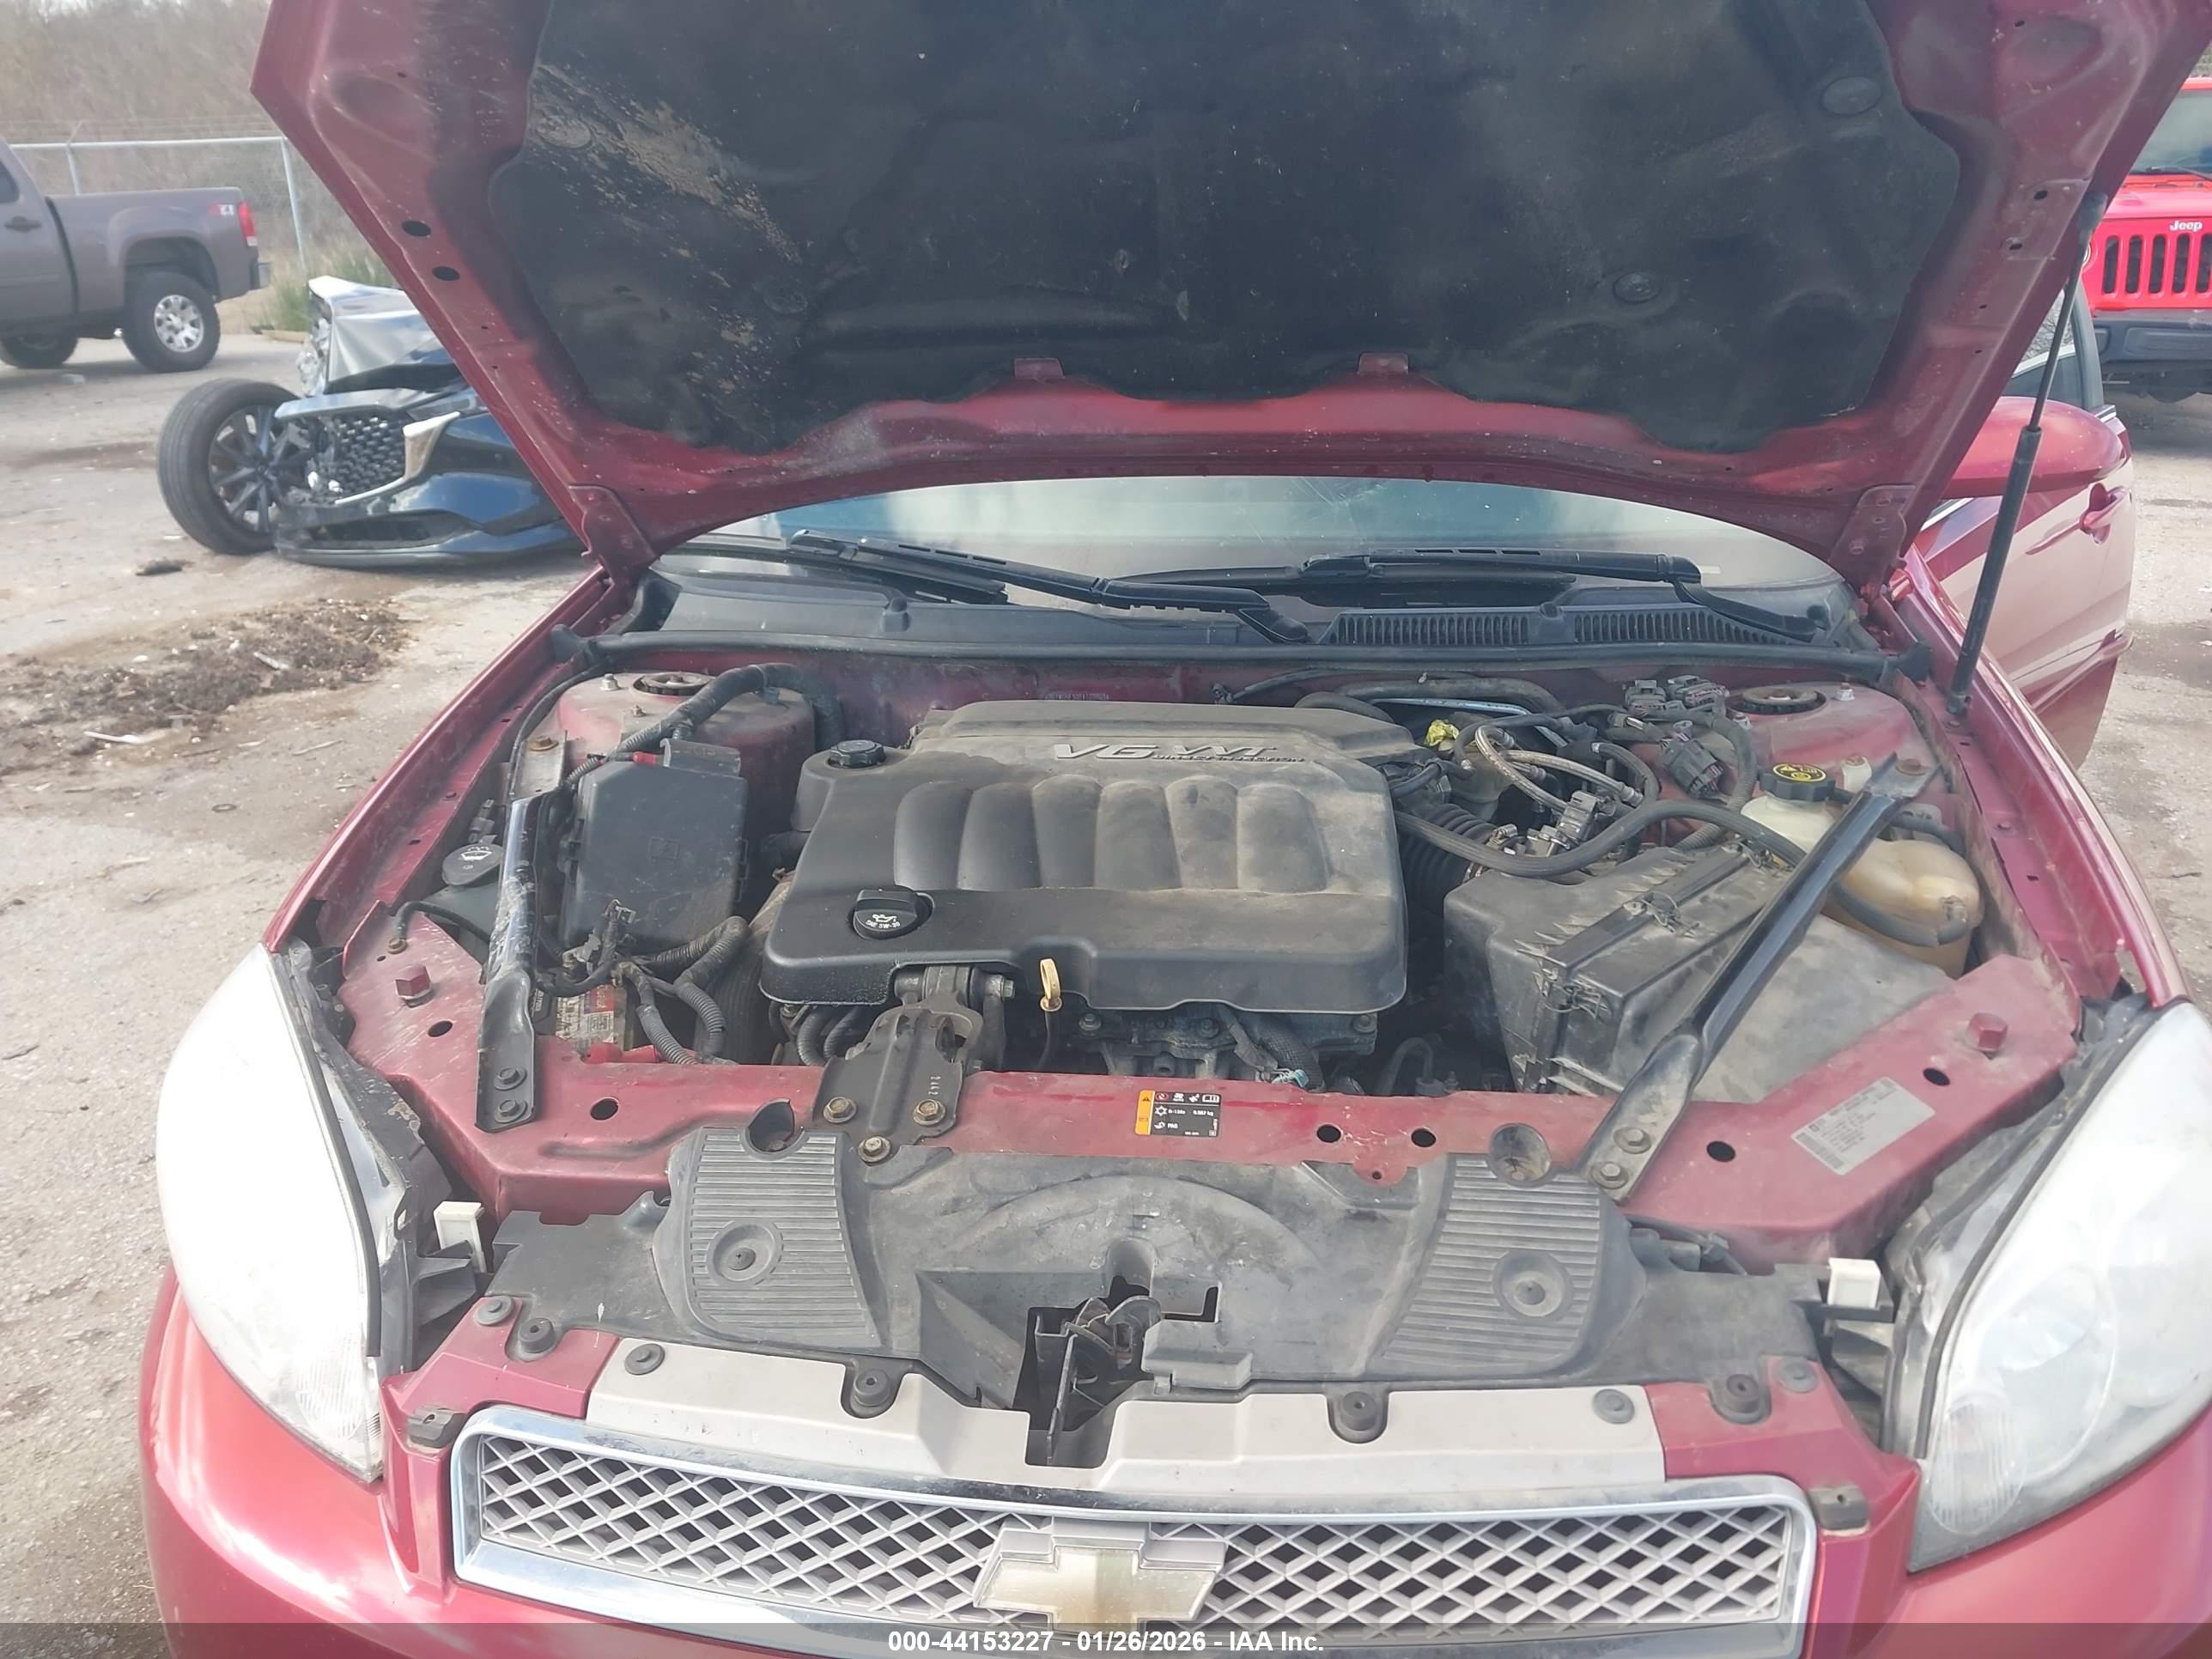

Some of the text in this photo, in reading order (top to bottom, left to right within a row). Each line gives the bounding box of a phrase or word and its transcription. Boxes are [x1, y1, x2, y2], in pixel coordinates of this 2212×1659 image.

[2169, 221, 2203, 232] Jeep
[1054, 744, 1278, 759] V6 VVT
